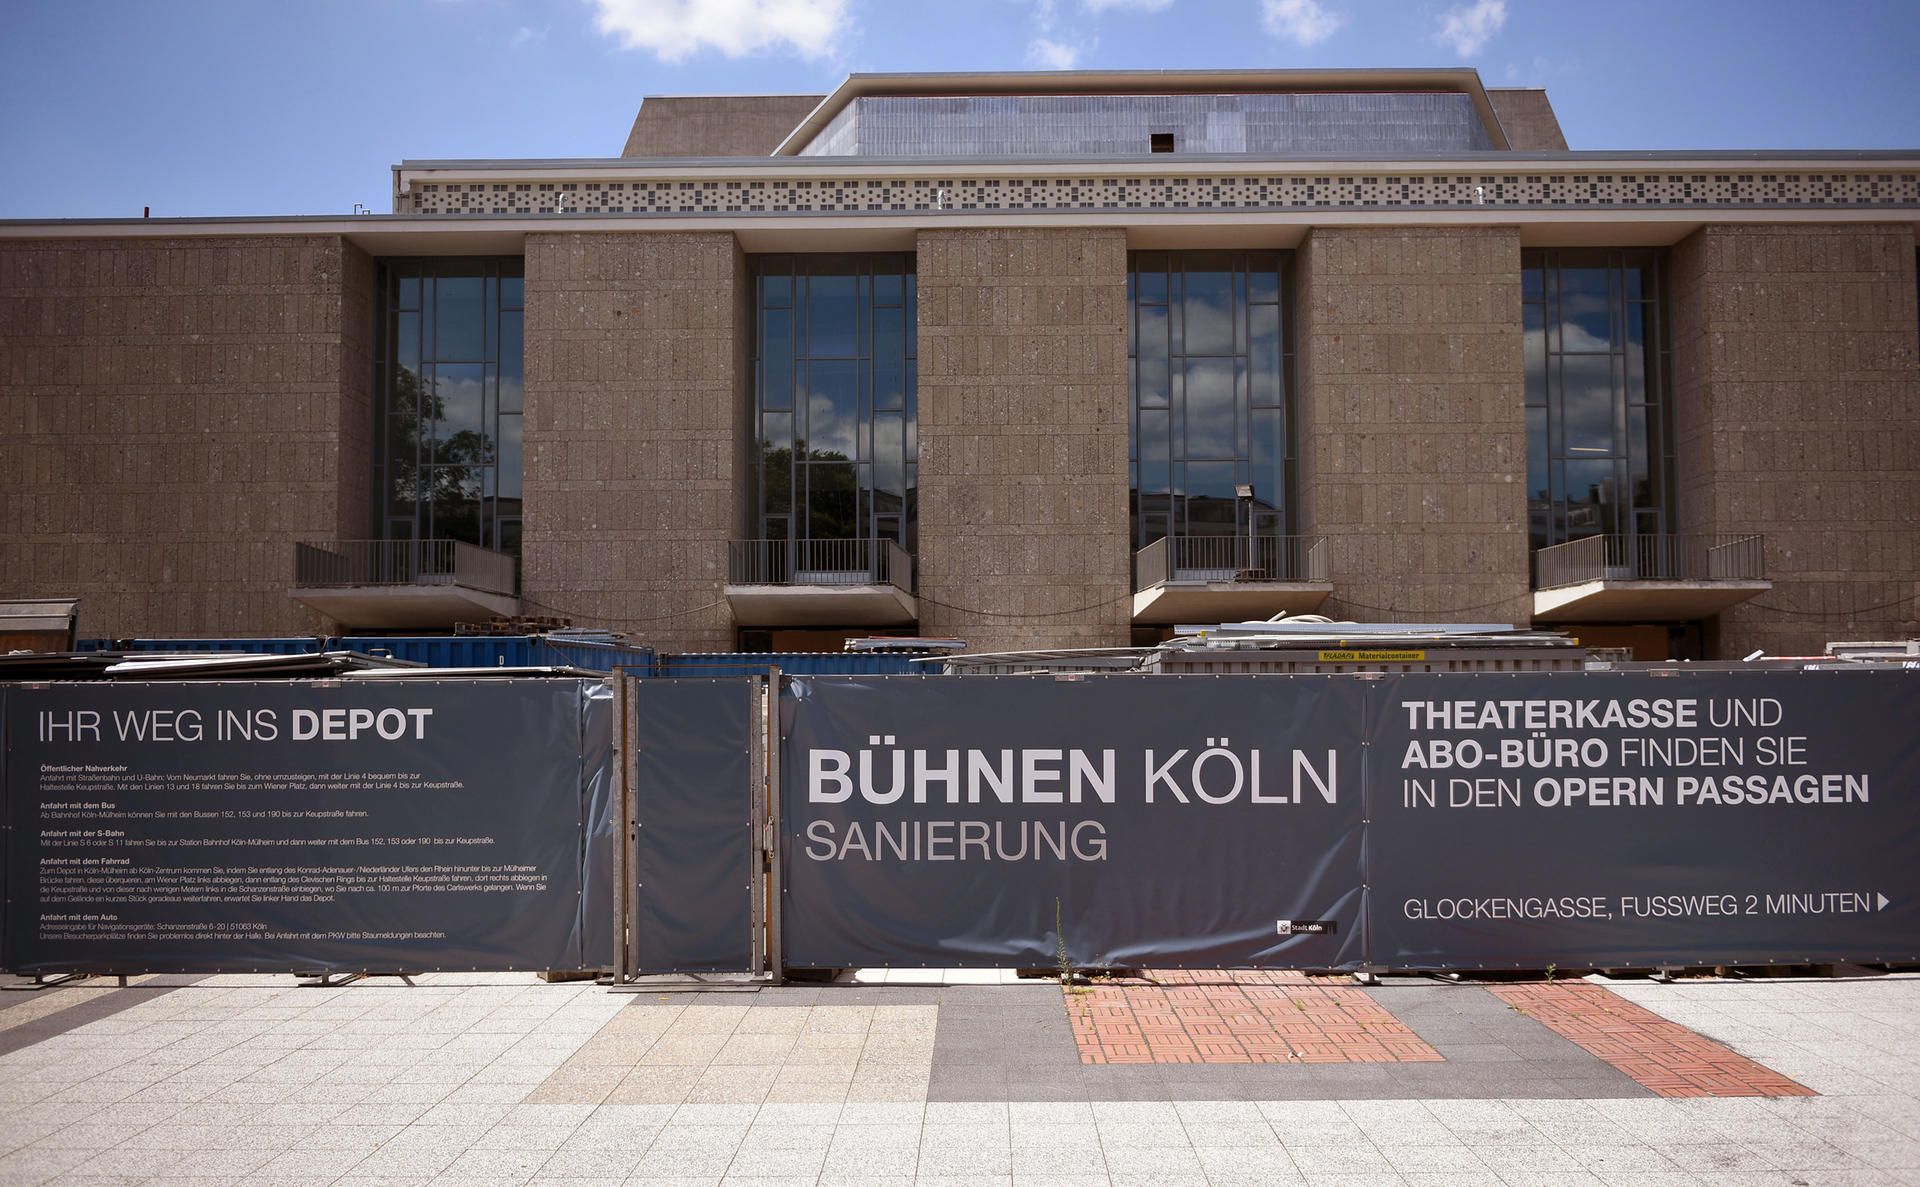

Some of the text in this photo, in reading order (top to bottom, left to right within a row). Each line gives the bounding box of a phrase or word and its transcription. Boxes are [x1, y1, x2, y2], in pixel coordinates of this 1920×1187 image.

[39, 707, 433, 742] IHR WEG INS DEPOT
[1401, 698, 1783, 730] THEATERKASSE UND
[1401, 731, 1808, 769] ABO-BÜRO FINDEN SIE
[40, 763, 83, 772] Öffentlicher
[808, 735, 1337, 805] BÜHNEN KÖLN
[1404, 774, 1869, 808] IN DEN OPERN PASSAGEN
[805, 820, 1107, 861] SANIERUNG
[1404, 892, 1870, 920] GLOCKENGASSE, FUSSWEG 2 MINUTEN
